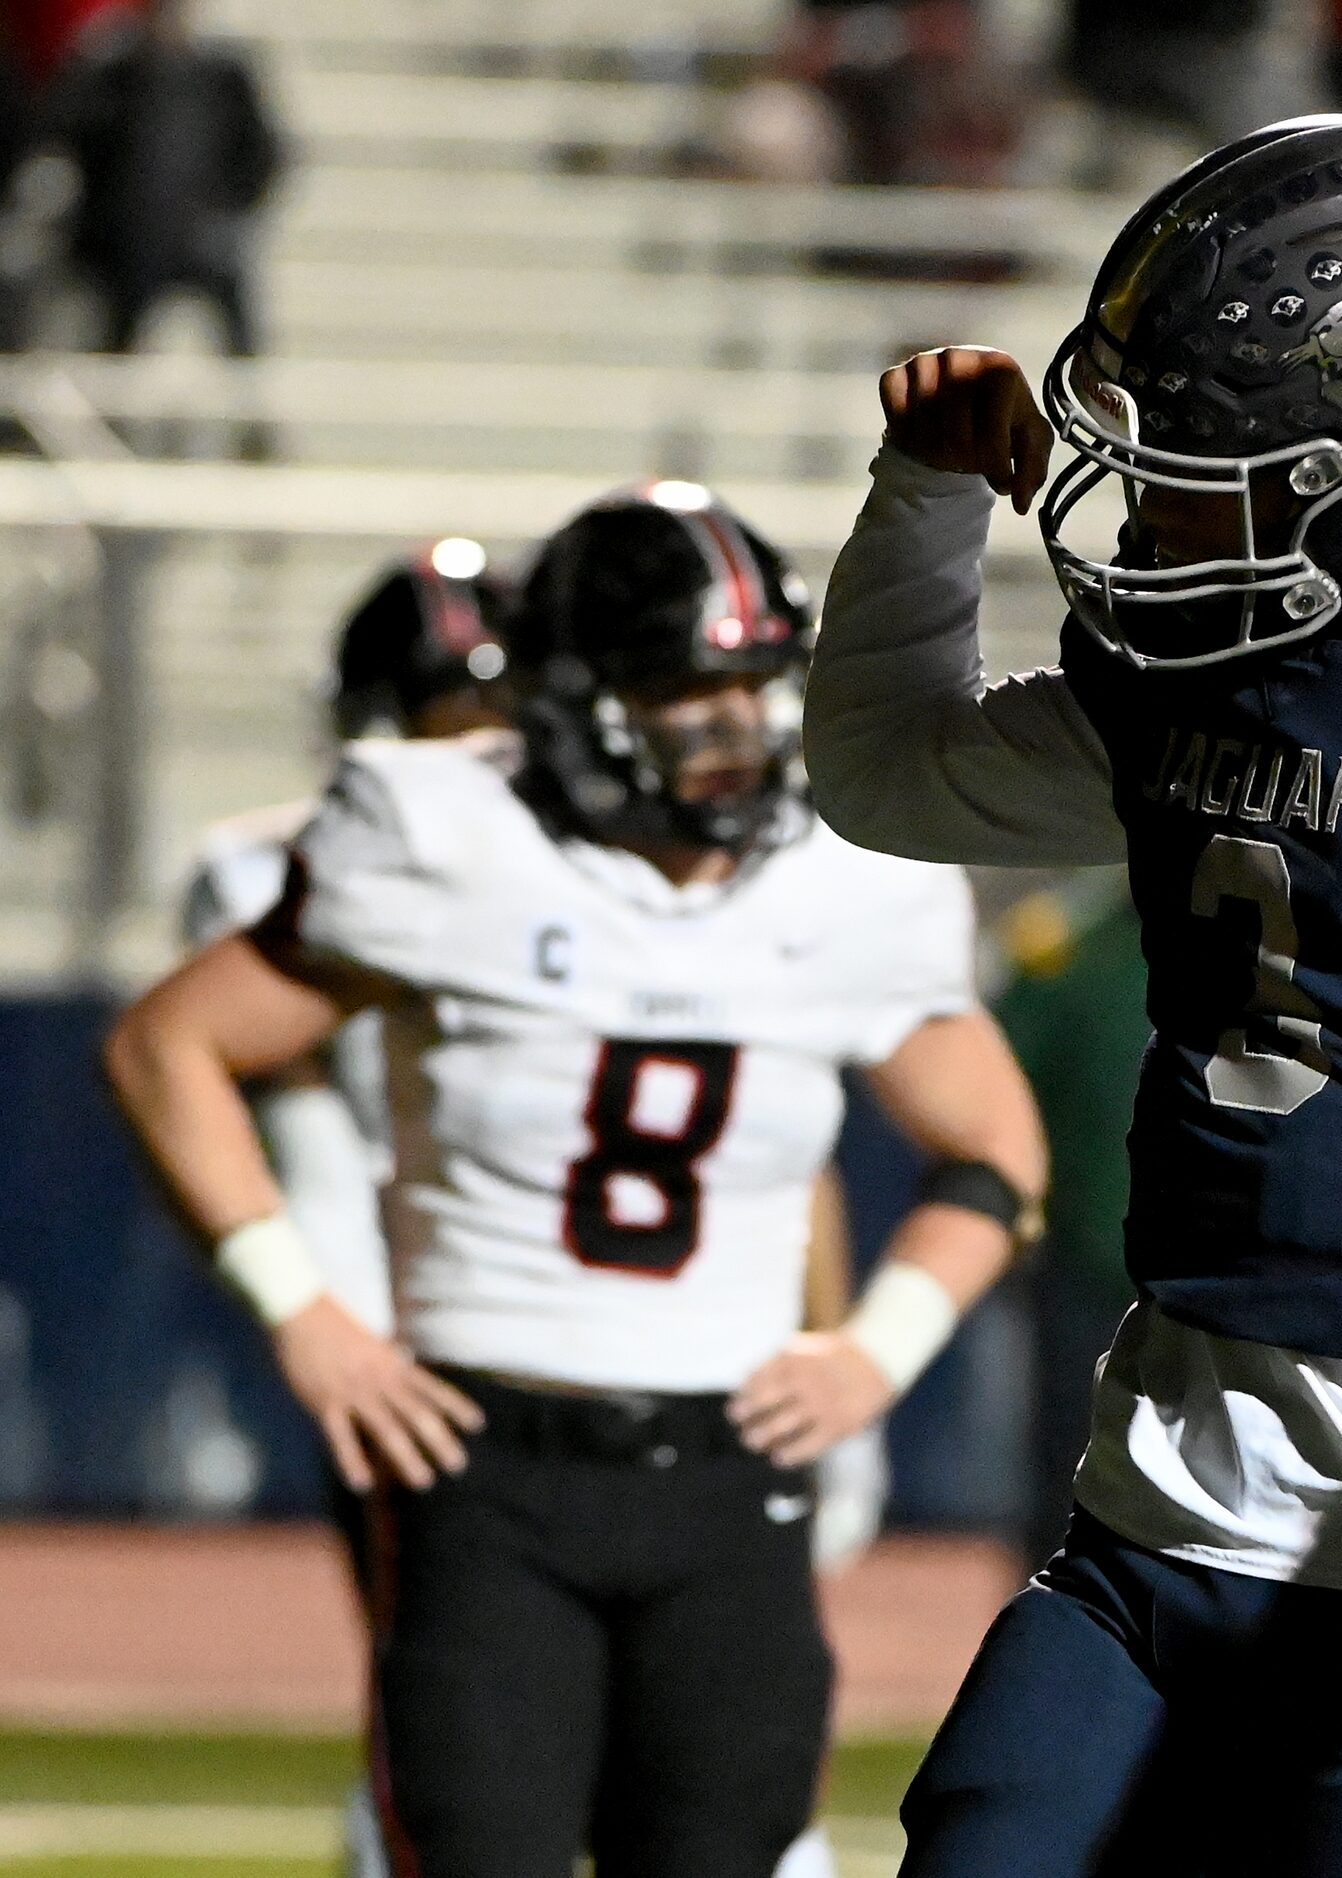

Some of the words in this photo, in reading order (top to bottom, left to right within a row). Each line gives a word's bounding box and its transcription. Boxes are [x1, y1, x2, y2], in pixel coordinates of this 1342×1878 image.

[535, 924, 571, 983] C
[1190, 833, 1330, 1116] 3
[562, 1038, 742, 1280] 8
